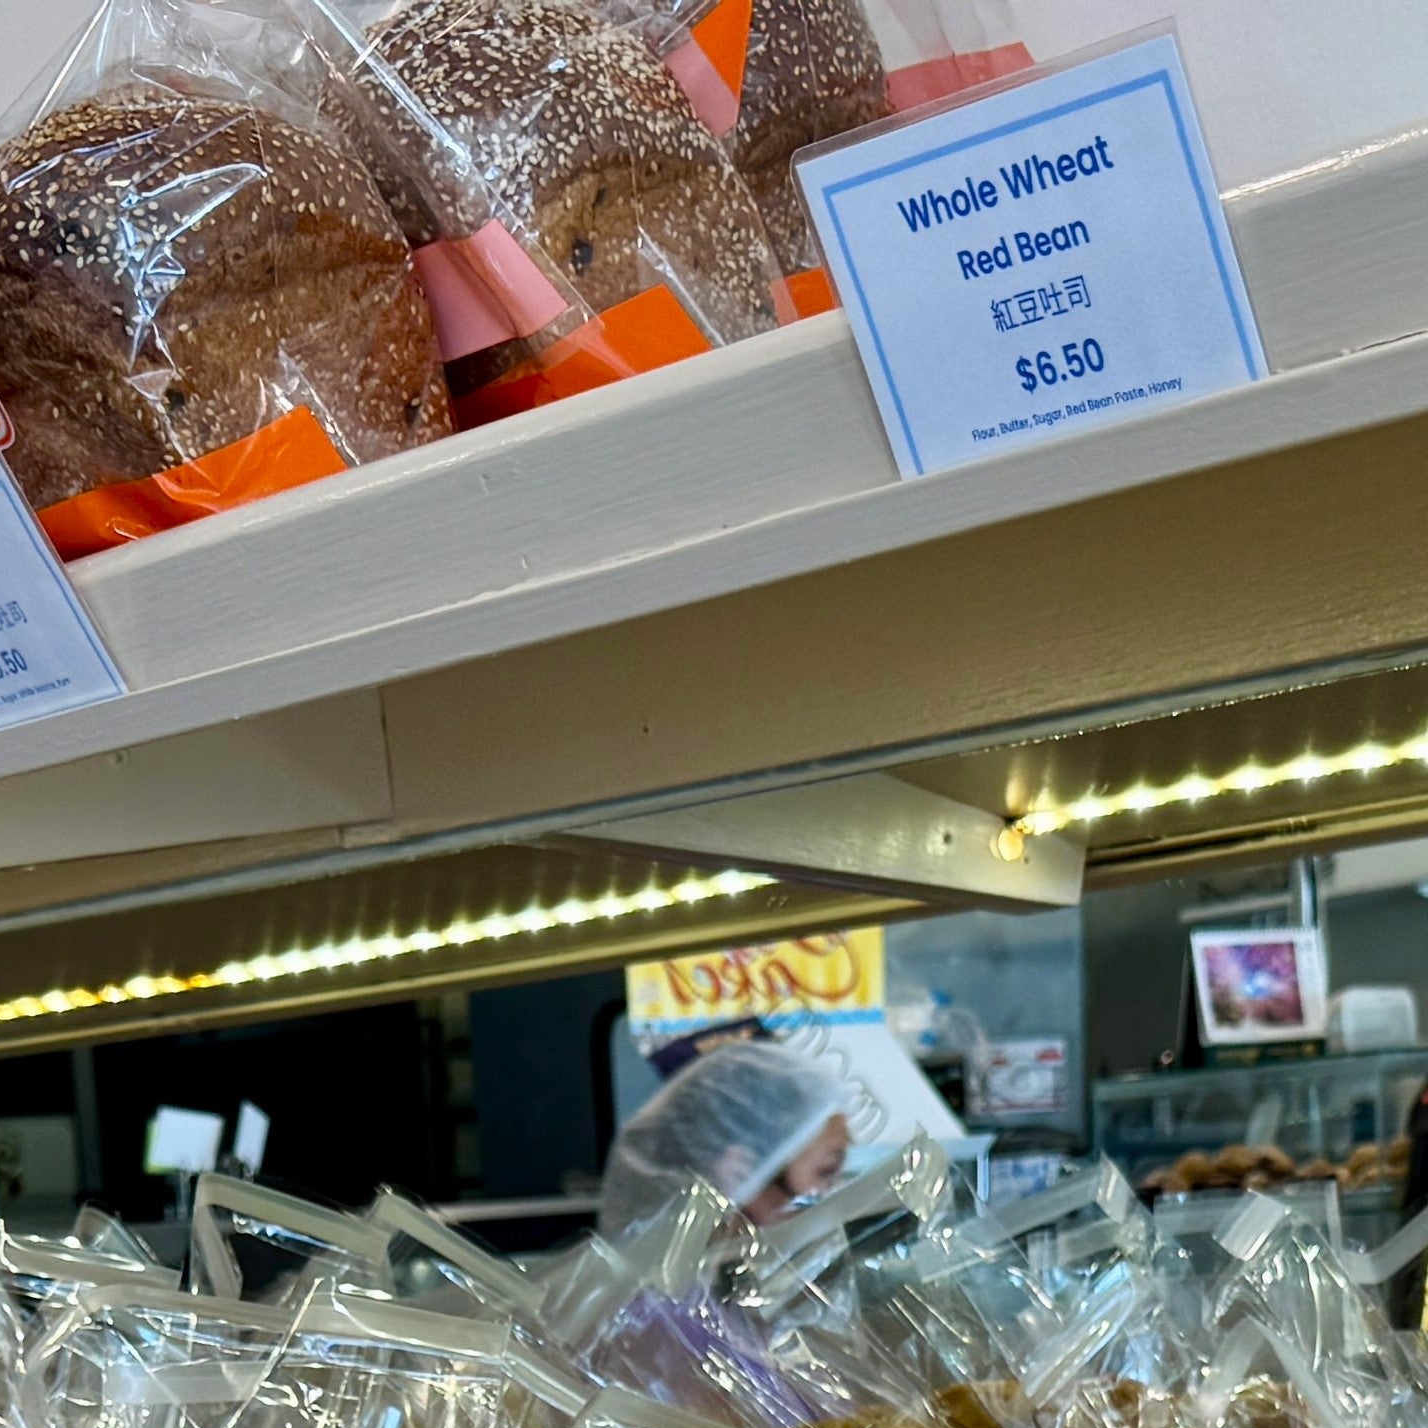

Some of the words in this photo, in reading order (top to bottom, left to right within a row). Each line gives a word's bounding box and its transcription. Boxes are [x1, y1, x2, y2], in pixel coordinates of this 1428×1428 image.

[897, 176, 999, 233] Whole
[999, 135, 1114, 200] Wheat
[957, 237, 1013, 280] Red
[1018, 219, 1091, 263] Bean
[990, 275, 1092, 333] 紅豆吐司
[1015, 337, 1105, 393] $6.50
